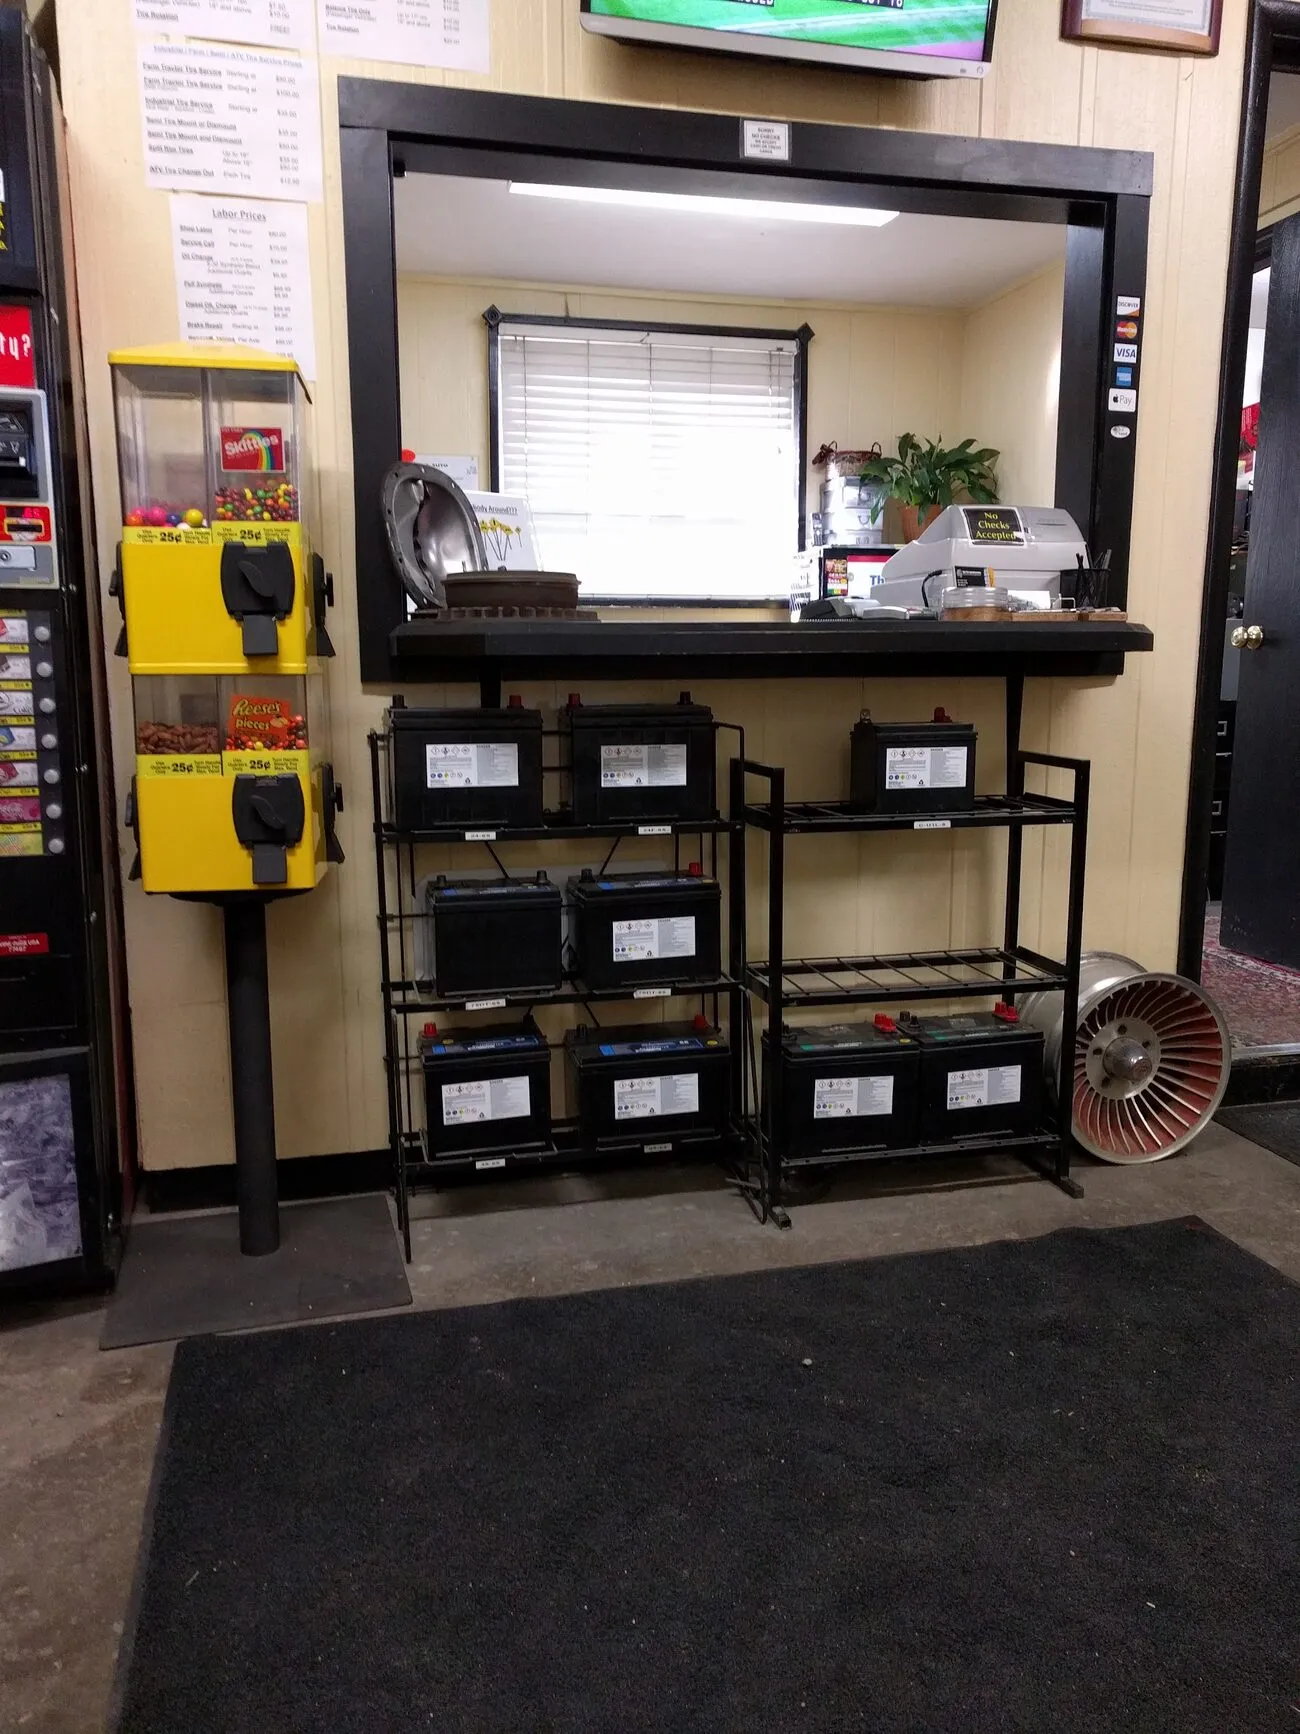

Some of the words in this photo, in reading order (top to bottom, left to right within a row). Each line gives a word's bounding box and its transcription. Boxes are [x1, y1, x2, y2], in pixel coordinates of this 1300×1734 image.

[212, 208, 237, 219] Labor
[240, 209, 267, 222] Prices
[1116, 348, 1136, 358] VISA
[1119, 395, 1132, 406] Pay
[225, 434, 279, 457] Skittles
[984, 512, 998, 520] No
[978, 520, 1010, 530] Checks
[160, 531, 182, 543] 25¢
[240, 529, 261, 541] 25¢
[975, 530, 1017, 541] Accepted
[233, 699, 280, 716] Reese's
[236, 717, 270, 730] pieces
[171, 762, 194, 773] 25¢
[250, 759, 271, 770] 25¢
